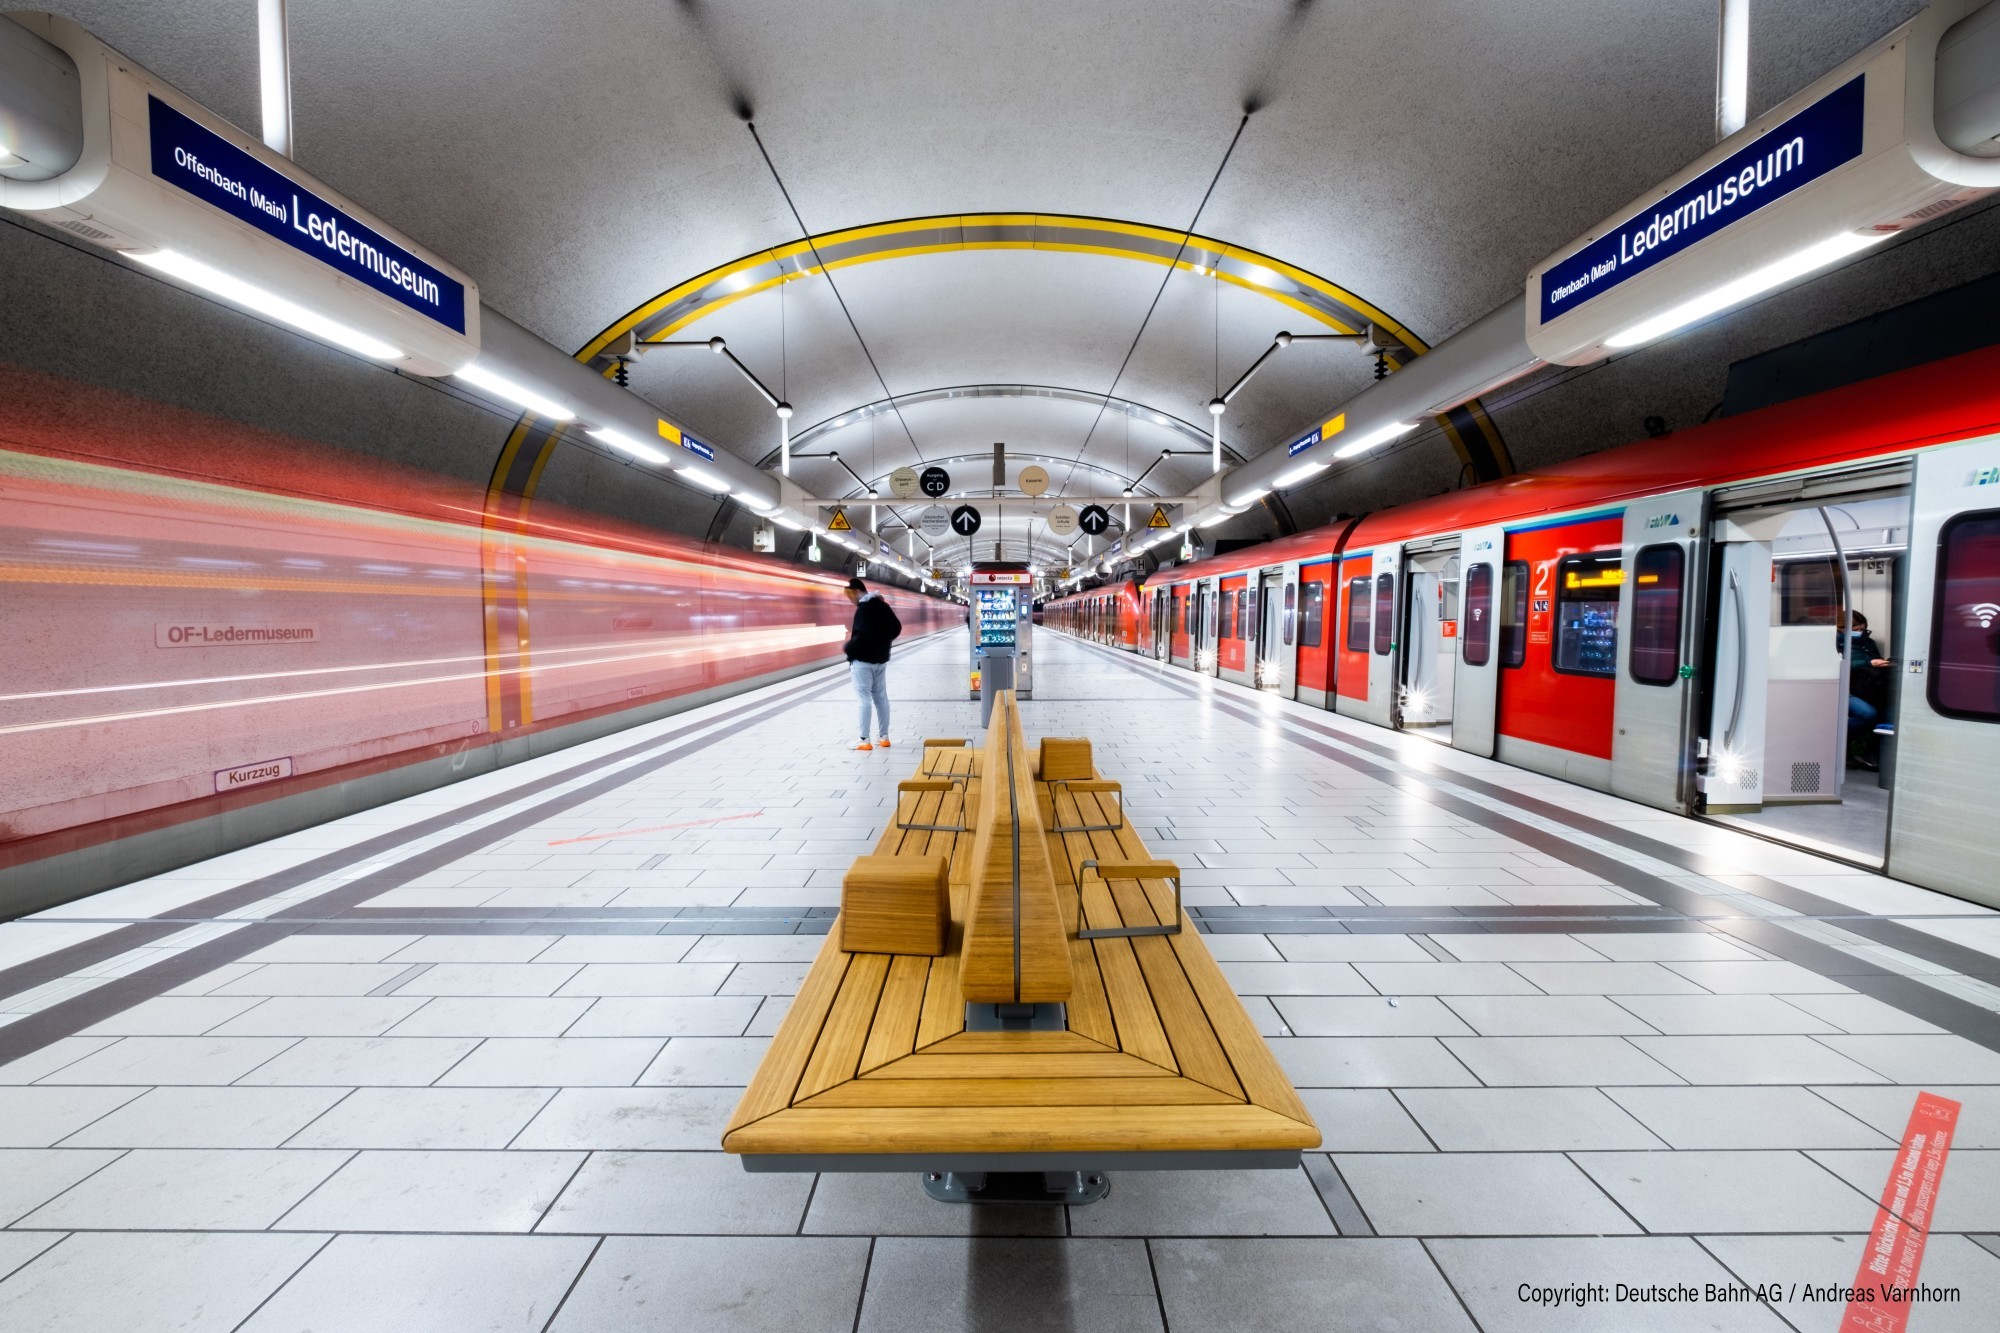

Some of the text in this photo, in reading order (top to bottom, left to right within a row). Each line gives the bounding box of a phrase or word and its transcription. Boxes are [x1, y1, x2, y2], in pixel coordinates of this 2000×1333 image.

[174, 146, 440, 307] Offenbach (Main) Ledermuseum
[1551, 137, 1804, 304] Offenbach (Main) Ledermuseum
[926, 482, 945, 491] C D
[1534, 561, 1549, 596] 2
[167, 625, 314, 643] OF-Ledermuseum
[229, 764, 280, 784] Kurzzug
[1895, 1183, 1910, 1199] und
[1875, 1220, 1900, 1256] Rücksicht
[1869, 1253, 1890, 1276] Bitte
